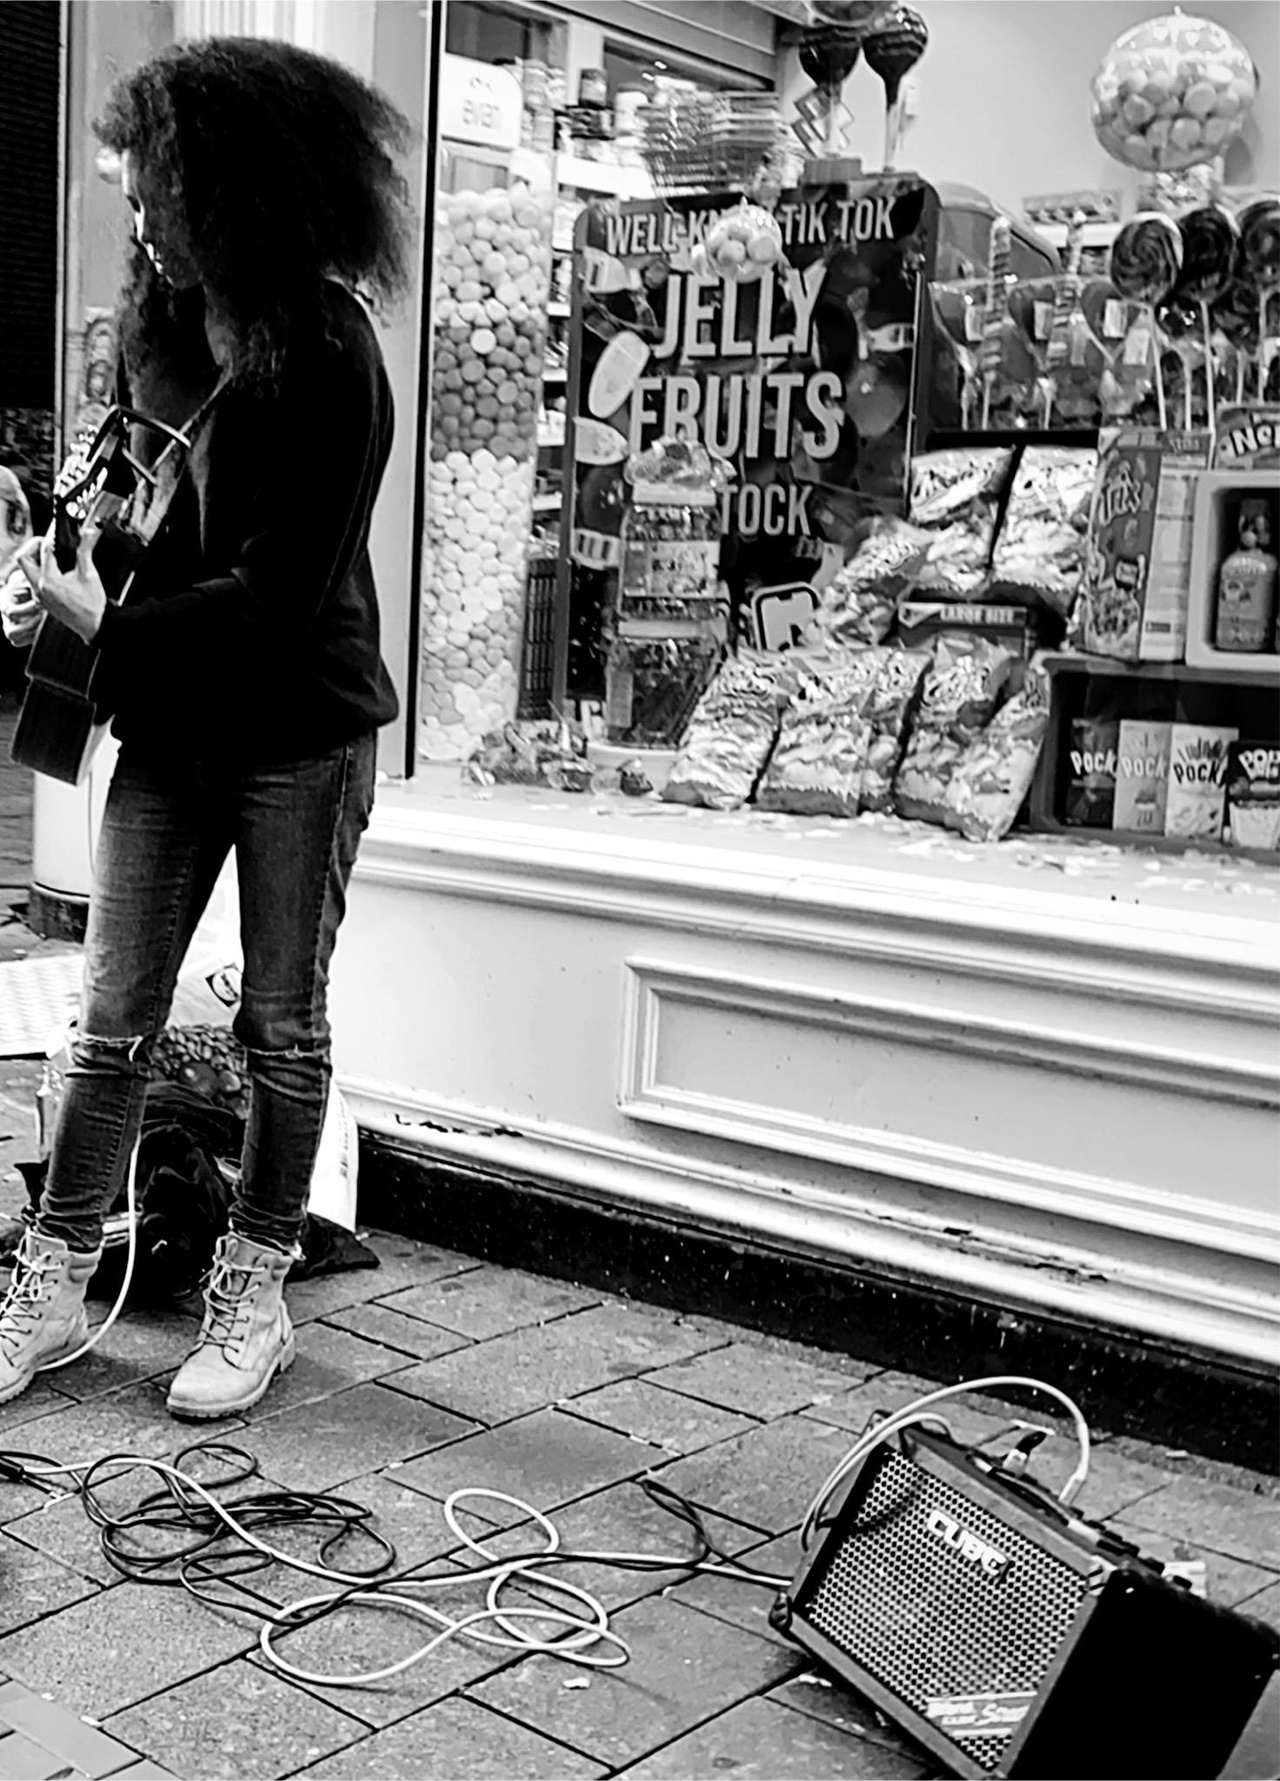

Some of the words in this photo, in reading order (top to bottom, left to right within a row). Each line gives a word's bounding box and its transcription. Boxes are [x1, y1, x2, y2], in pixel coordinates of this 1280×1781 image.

[781, 202, 828, 246] TIK
[836, 196, 897, 241] TOK
[651, 266, 828, 359] JELLY
[628, 371, 845, 460] FRUITS
[717, 483, 814, 537] TOCK
[1069, 750, 1117, 777] POCK
[1121, 753, 1169, 779] POCK
[926, 1508, 1008, 1577] CUBE
